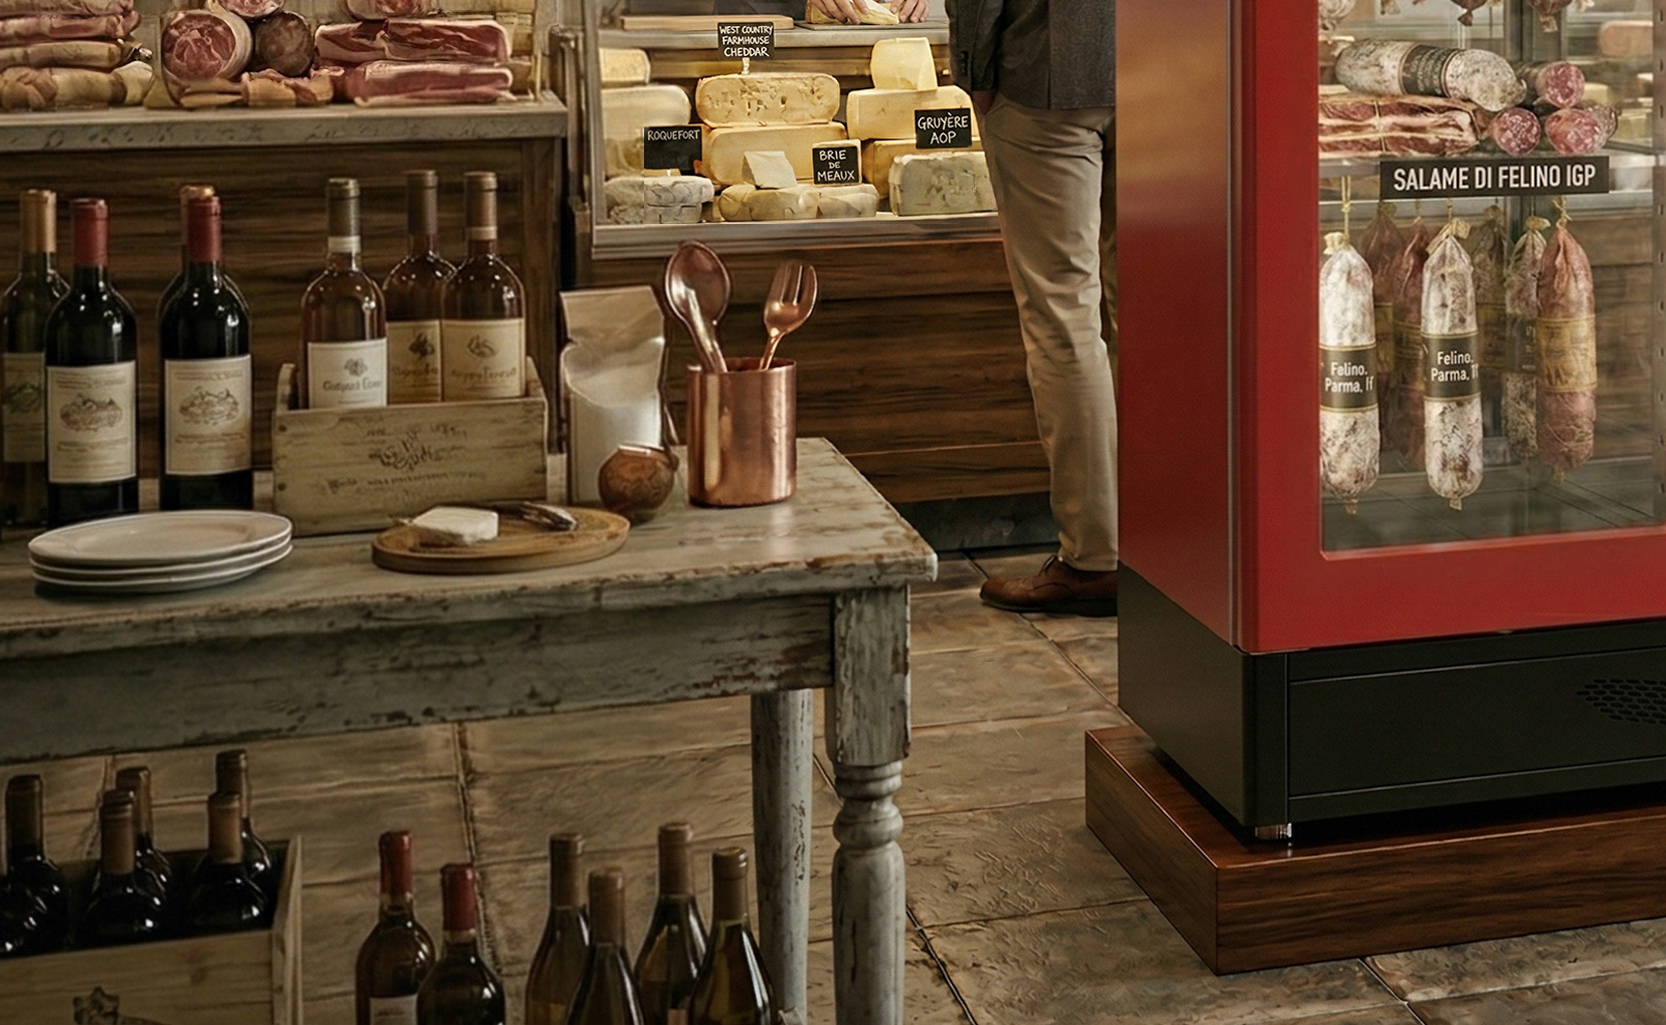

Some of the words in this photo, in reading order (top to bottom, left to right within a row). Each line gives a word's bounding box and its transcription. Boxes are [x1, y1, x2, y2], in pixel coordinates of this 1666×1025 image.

[719, 26, 739, 35] WEST
[741, 25, 774, 35] COUNTRY
[722, 36, 770, 45] FARMHOUSE
[724, 47, 770, 57] CHEDDAR
[917, 112, 969, 131] GRUYÈRE
[647, 129, 700, 140] ROQUEFORT
[930, 131, 957, 145] AOP
[820, 150, 847, 161] BRIE
[829, 161, 841, 169] DE
[817, 170, 855, 181] MEAUX
[1394, 167, 1469, 192] SALAME
[1474, 166, 1492, 189] DI
[1498, 164, 1561, 188] FELINO
[1566, 163, 1596, 187] IGP
